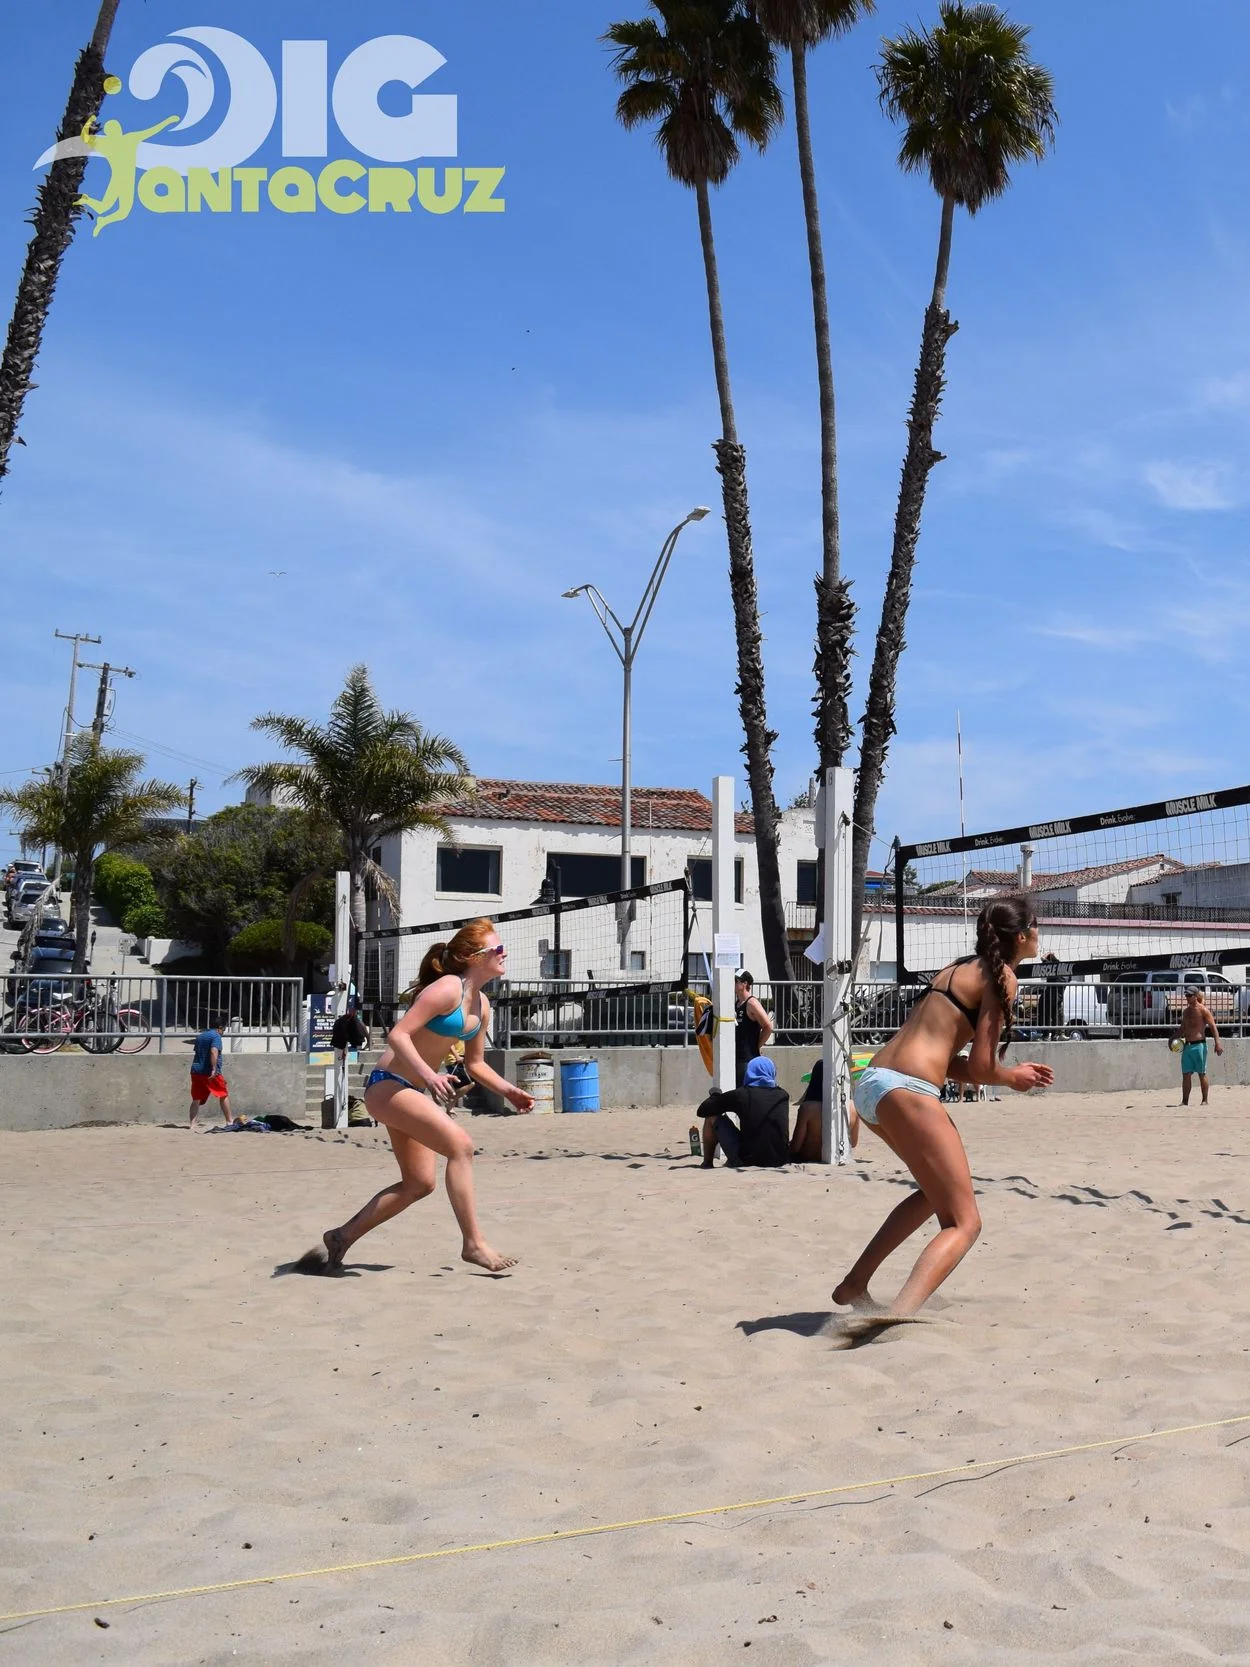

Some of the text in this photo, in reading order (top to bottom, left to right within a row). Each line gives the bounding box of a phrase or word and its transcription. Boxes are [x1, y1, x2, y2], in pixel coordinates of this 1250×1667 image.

[1165, 794, 1217, 816] MUSCLE MILK
[1028, 820, 1072, 840] MUSCLE MILK
[1169, 952, 1222, 969] MUSCLE MILK
